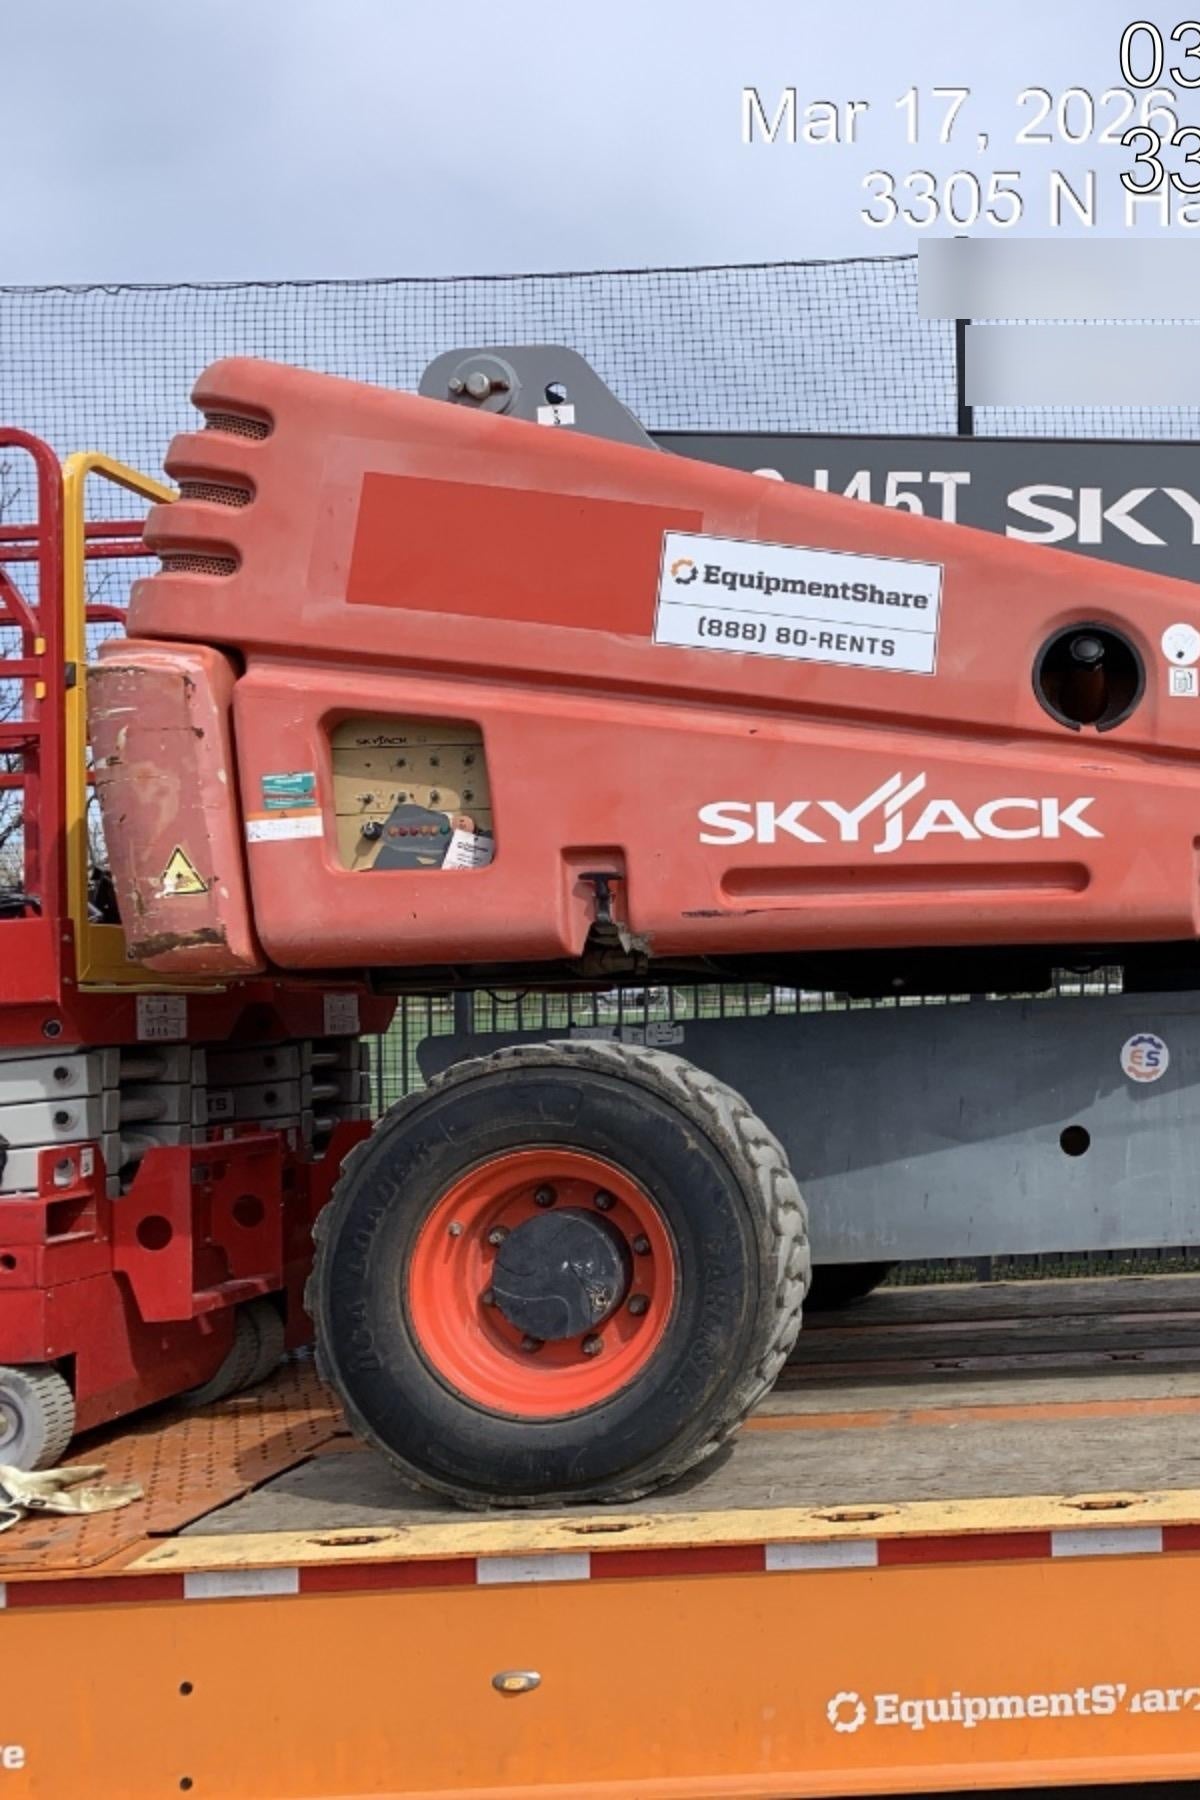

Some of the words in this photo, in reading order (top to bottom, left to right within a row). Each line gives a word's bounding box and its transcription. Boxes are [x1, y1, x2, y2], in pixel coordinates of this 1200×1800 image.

[703, 564, 929, 610] EquipmentShare
[697, 616, 767, 643] (888)
[775, 626, 896, 657] 80-RENTS
[698, 772, 1105, 853] SKYJACK
